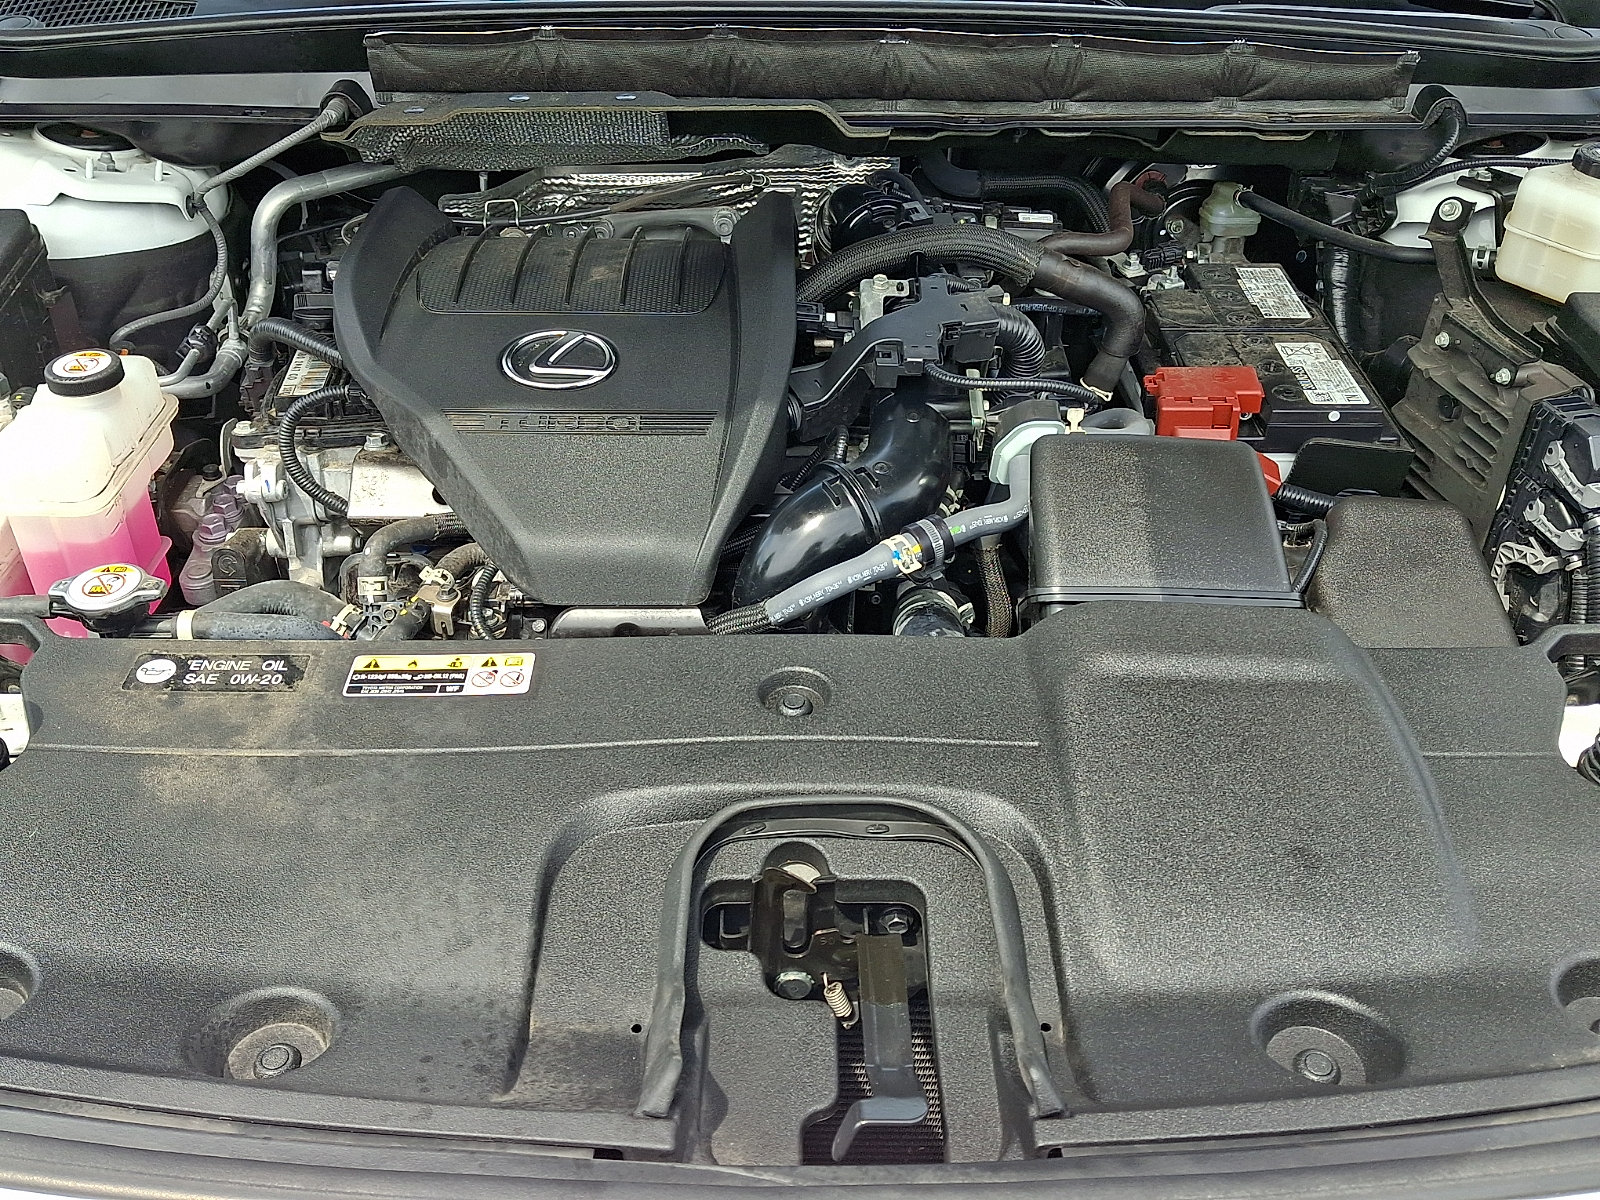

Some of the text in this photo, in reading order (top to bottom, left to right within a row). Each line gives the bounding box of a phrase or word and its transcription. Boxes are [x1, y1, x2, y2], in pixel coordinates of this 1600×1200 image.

[189, 659, 288, 671] ENGINE OIL
[182, 673, 283, 685] SAE 0W-20
